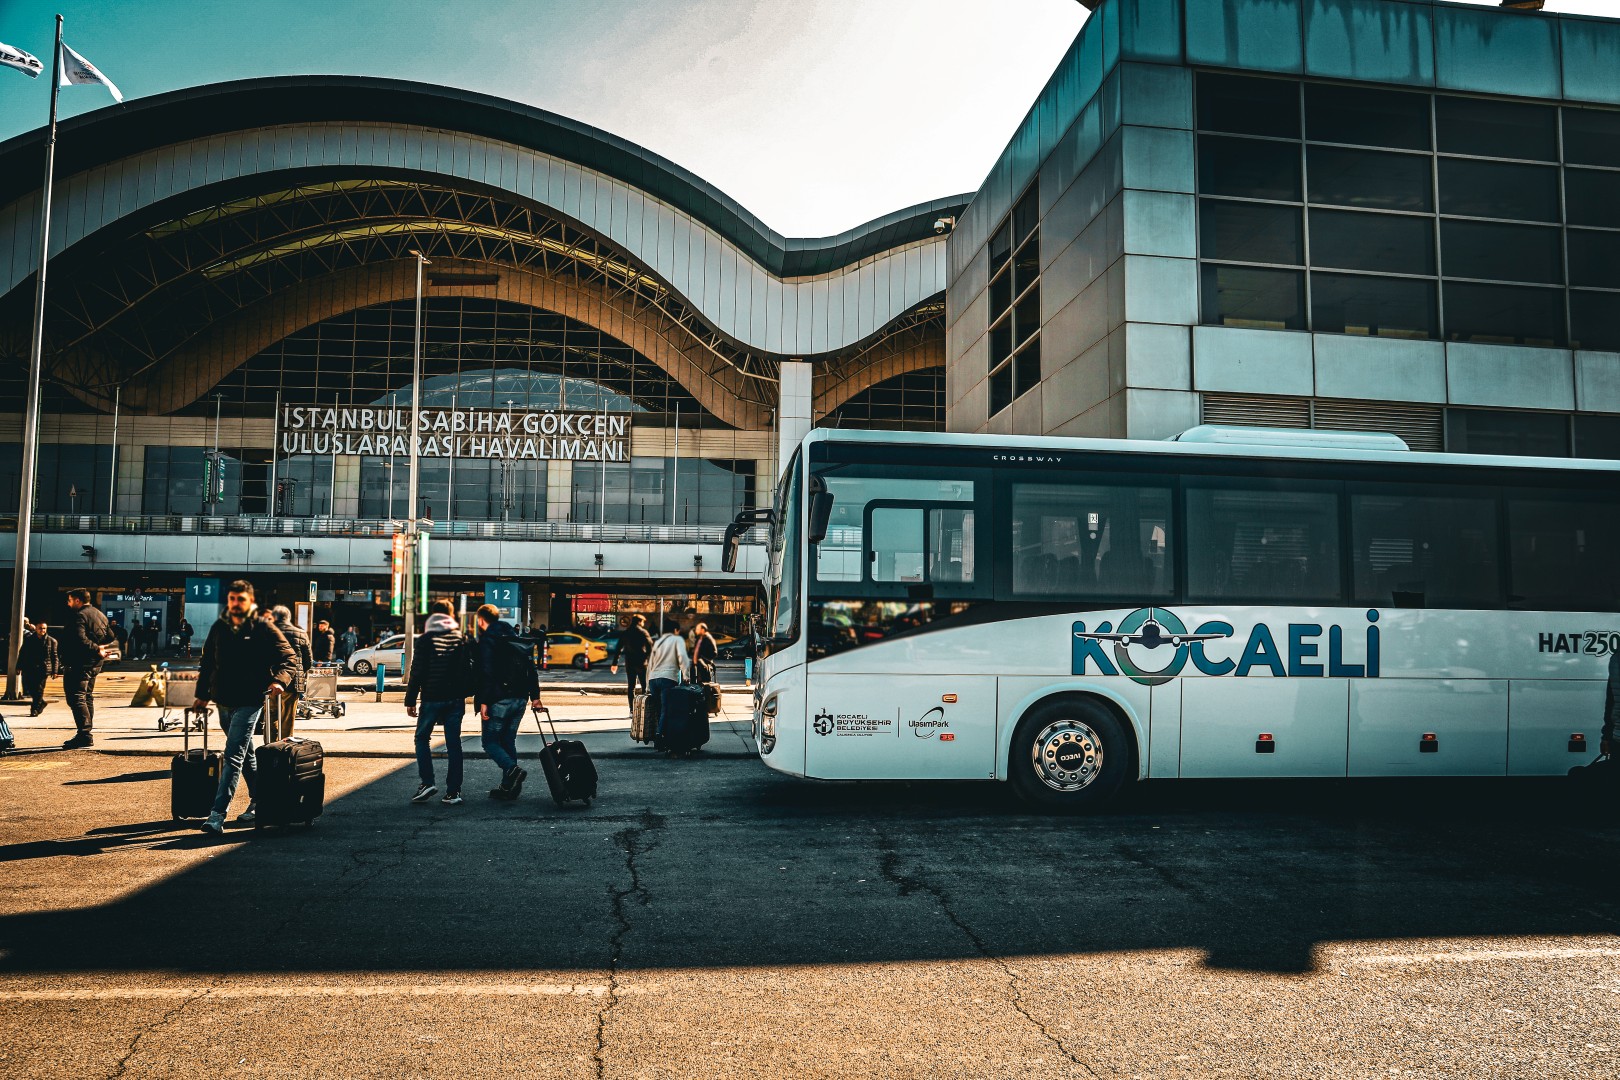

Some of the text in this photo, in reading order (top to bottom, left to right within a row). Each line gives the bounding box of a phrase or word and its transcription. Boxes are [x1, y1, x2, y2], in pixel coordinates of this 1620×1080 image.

[283, 403, 624, 441] İSTANBUL SABİHA GÖKÇEN
[470, 435, 623, 461] HAVALİMANI
[492, 589, 511, 600] 12
[1060, 753, 1081, 761] IVECO
